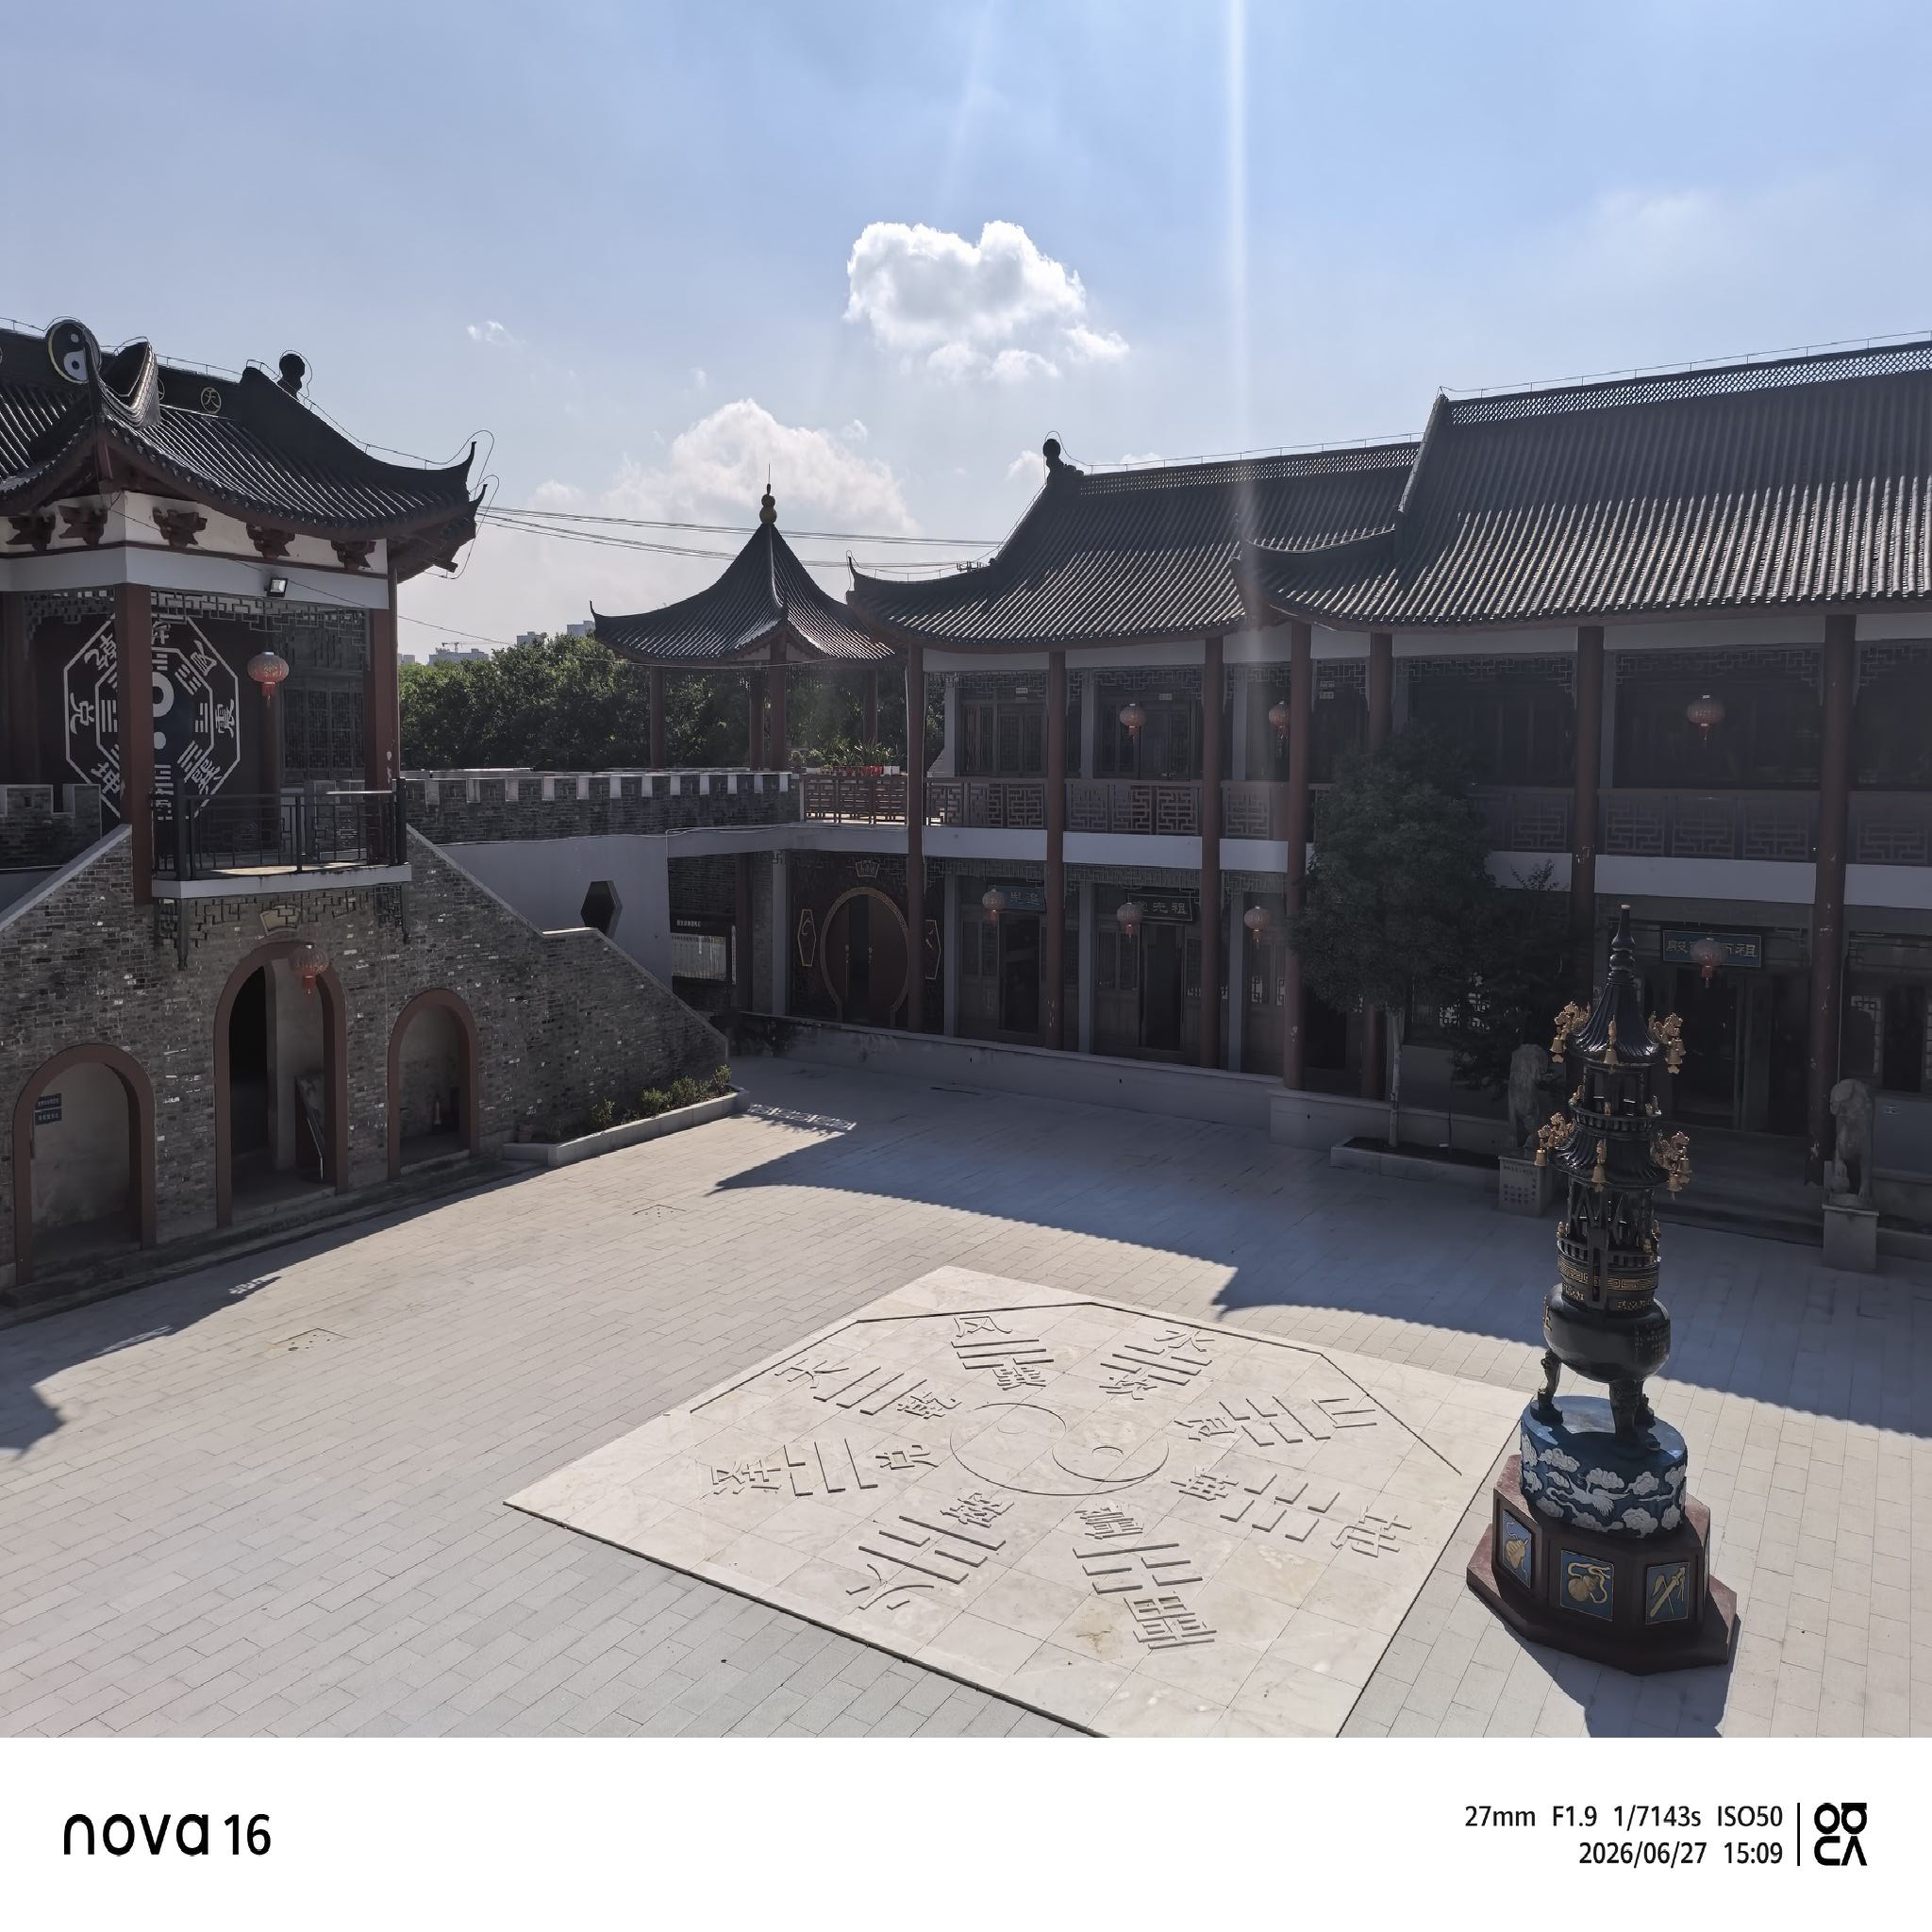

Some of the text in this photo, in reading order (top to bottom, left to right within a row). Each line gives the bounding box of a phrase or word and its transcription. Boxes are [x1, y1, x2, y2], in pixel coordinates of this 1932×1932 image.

[191, 640, 217, 676] 艮
[215, 699, 235, 738] 震
[91, 762, 120, 794] 坤
[192, 758, 223, 795] 巽
[954, 1315, 1013, 1338] 风
[1154, 1329, 1216, 1353] 水
[774, 1358, 850, 1390] 天
[992, 1367, 1047, 1391] 巽
[1099, 1374, 1158, 1401] 坎
[1311, 1397, 1377, 1429] 山
[1331, 1507, 1412, 1557] 地
[846, 1563, 935, 1611] 火
[1124, 1593, 1218, 1650] 雷
